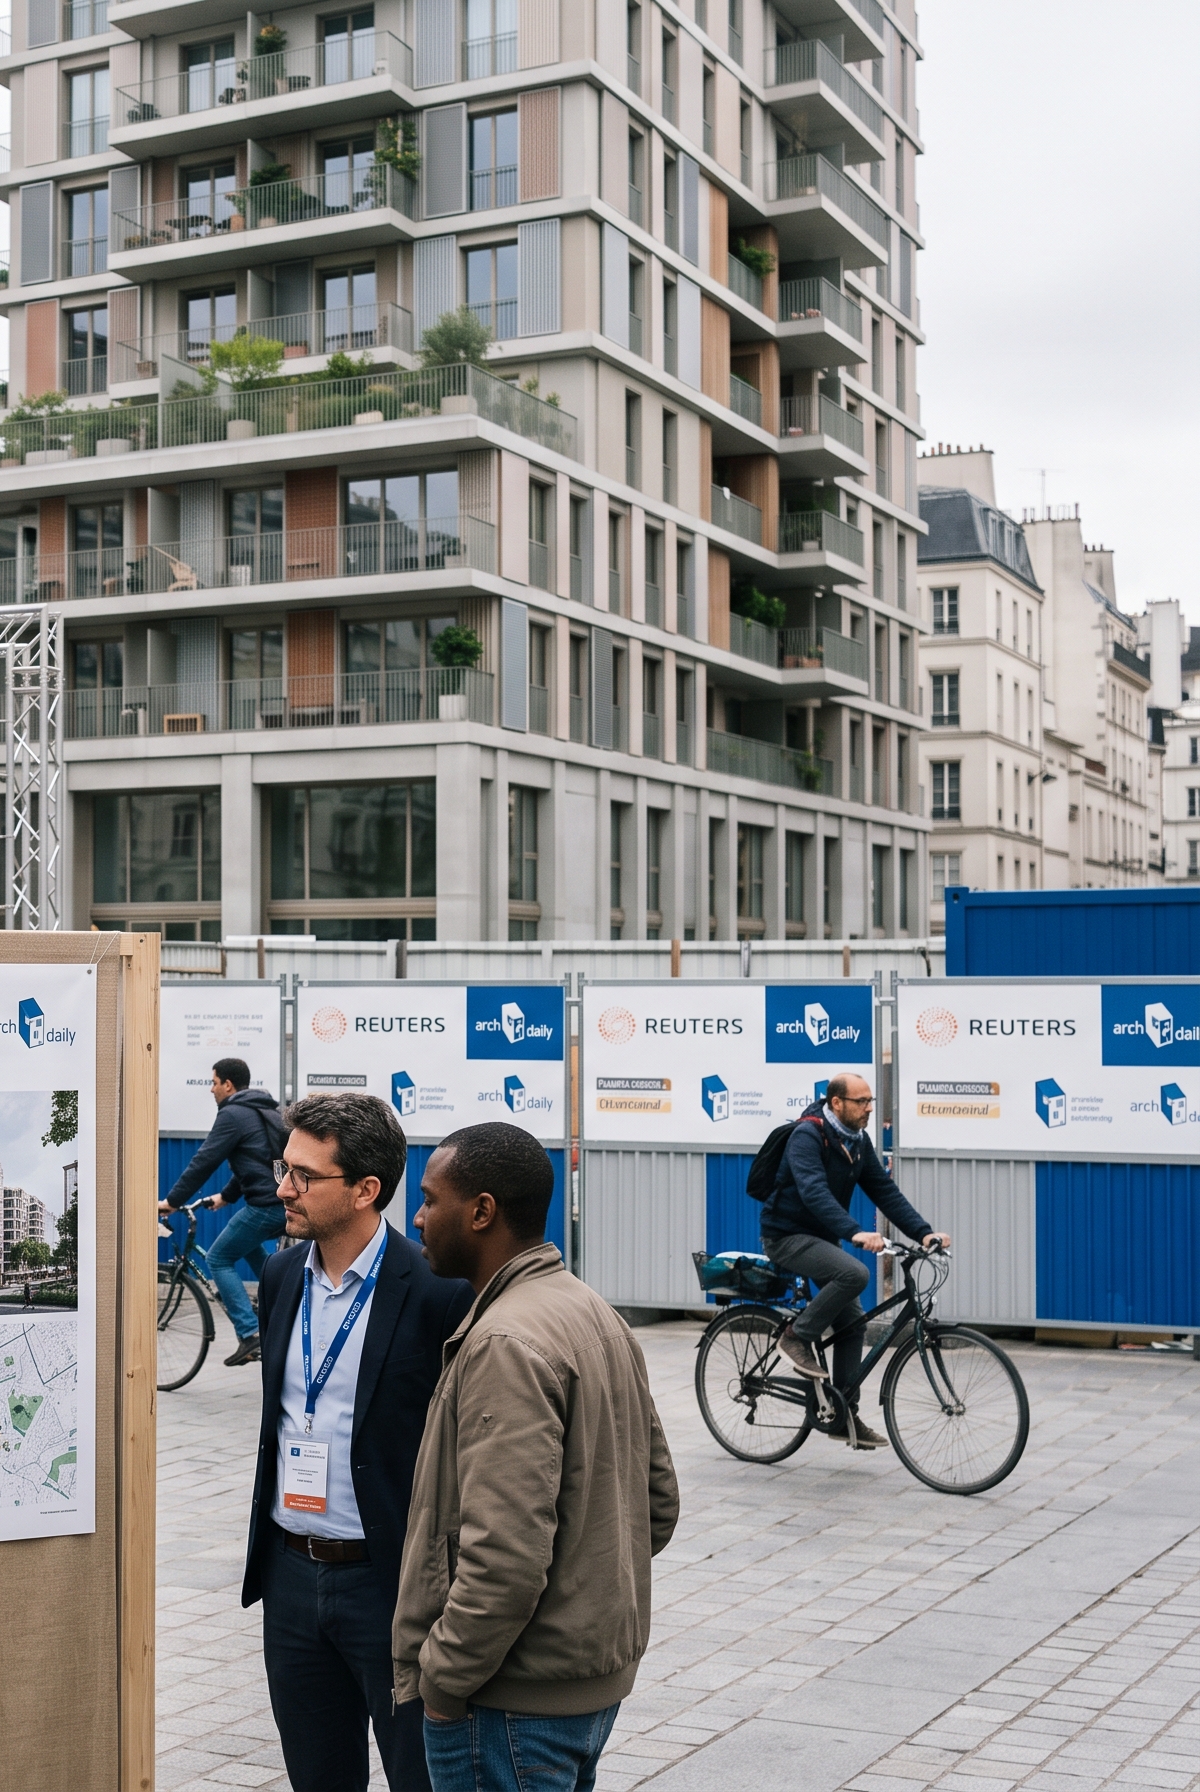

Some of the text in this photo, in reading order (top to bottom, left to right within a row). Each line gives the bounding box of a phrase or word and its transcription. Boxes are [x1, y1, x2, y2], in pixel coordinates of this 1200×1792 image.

[355, 1016, 446, 1033] REUTERS
[475, 1018, 553, 1041] arch daily
[645, 1018, 743, 1035] REUTERS
[775, 1019, 861, 1043] arch daily
[969, 1019, 1077, 1036] REUTERS
[1112, 1020, 1200, 1041] arch dail
[46, 1026, 76, 1046] daily
[477, 1089, 553, 1112] arch daily
[1130, 1099, 1160, 1113] arch
